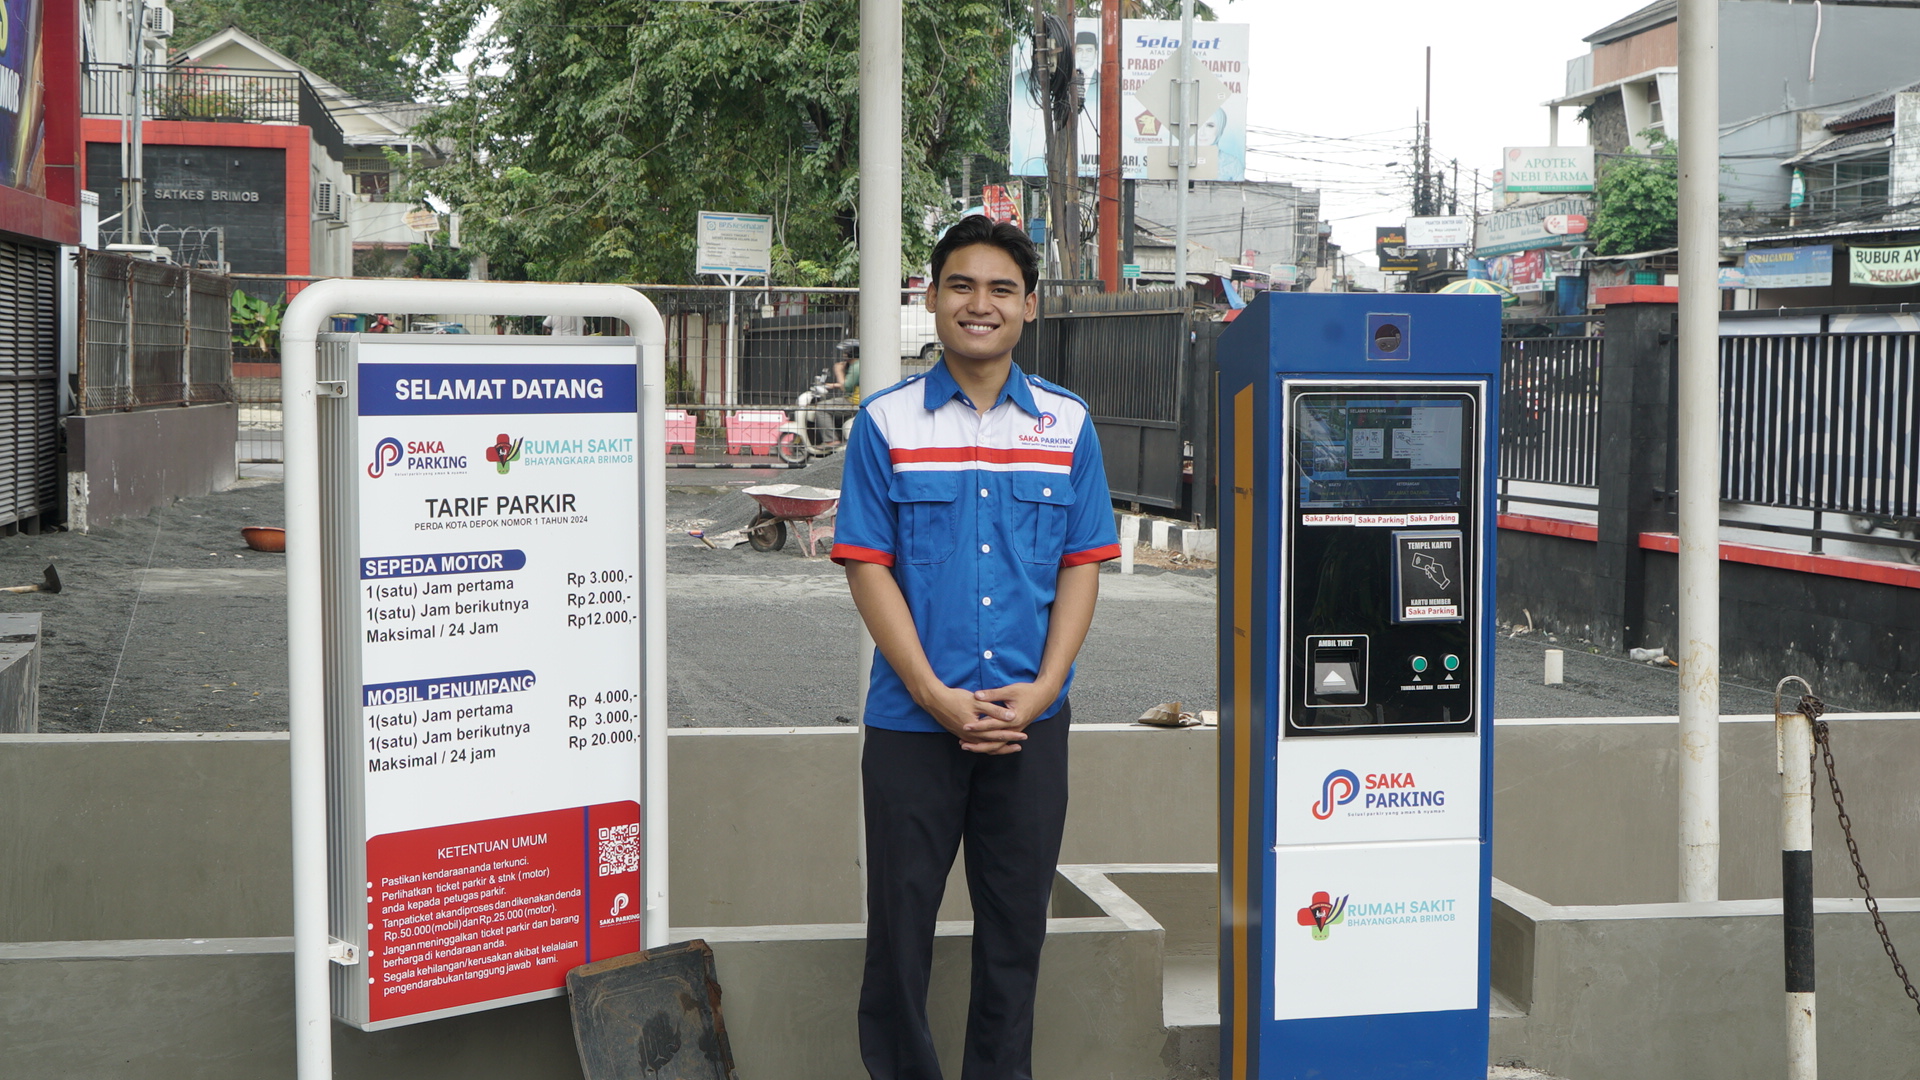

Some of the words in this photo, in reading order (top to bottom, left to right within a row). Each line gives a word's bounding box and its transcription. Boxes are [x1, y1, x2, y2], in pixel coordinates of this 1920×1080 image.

[1128, 58, 1167, 71] PRABO
[1524, 158, 1577, 169] APOTEK
[1510, 171, 1540, 182] NEBI
[1545, 171, 1589, 182] FARMA
[154, 188, 205, 200] SATKES
[211, 190, 260, 202] BRIMOB
[1486, 210, 1522, 233] APOTEK
[1523, 205, 1546, 226] NEBI
[1856, 250, 1900, 264] BUBUR
[395, 378, 506, 400] SELAMAT
[512, 378, 604, 399] DATANG
[407, 441, 445, 454] SAKA
[525, 439, 583, 455] RUMAH
[587, 438, 633, 453] SAKIT
[1018, 435, 1040, 443] SAKA
[1040, 437, 1073, 445] PARKING
[408, 456, 467, 470] PARKING
[525, 455, 596, 467] BHAYANGKARA
[598, 454, 633, 464] BRIMOB
[425, 496, 489, 519] TARIF
[497, 493, 577, 515] PARKIR
[414, 521, 443, 531] PERDA
[446, 519, 468, 529] KOTA
[469, 518, 499, 528] DEPOK
[501, 517, 532, 527] NOMOR
[534, 517, 539, 526] 1
[541, 516, 568, 525] TAHUN
[570, 515, 588, 524] 2024
[1325, 515, 1353, 523] Parking
[1377, 517, 1405, 525] Parking
[1429, 514, 1456, 523] Parking
[1407, 541, 1431, 550] TEMPEL
[1431, 541, 1452, 549] KARTU
[365, 557, 437, 577] SEPEDA
[441, 553, 503, 572] MOTOR
[422, 582, 452, 595] Jam
[457, 578, 514, 597] pertama
[567, 572, 585, 587] Rp
[589, 569, 633, 585] 3.000,-
[420, 603, 450, 618] Jam
[455, 598, 529, 616] berikutnya
[567, 593, 585, 608] Rp
[588, 590, 631, 606] 2.000,-
[1410, 598, 1428, 606] KARTU
[1428, 598, 1451, 606] MEMBER
[1427, 607, 1455, 616] Parking
[367, 625, 436, 643] Maksimal
[440, 624, 445, 638] /
[448, 623, 465, 637] 24
[469, 621, 499, 635] Jam
[1318, 639, 1337, 647] AMBIL
[1337, 639, 1354, 647] TIKET
[367, 687, 423, 706] MOBIL
[428, 675, 535, 700] PENUMPANG
[422, 708, 451, 723] Jam
[456, 704, 513, 723] pertama
[568, 694, 587, 709] Rp
[594, 688, 638, 705] 4.000,-
[422, 731, 451, 745] Jam
[456, 722, 530, 742] berikutnya
[568, 714, 587, 729] Rp
[594, 709, 638, 726] 3.000,-
[368, 753, 437, 773] Maksimal
[441, 751, 446, 766] /
[450, 749, 467, 764] 24
[470, 747, 496, 764] jam
[568, 735, 587, 751] Rp
[591, 729, 641, 747] 20.000,-
[1365, 772, 1415, 790] SAKA
[1366, 790, 1445, 809] PARKING
[437, 838, 509, 860] KETENTUAN
[511, 833, 548, 848] UMUM
[381, 874, 421, 887] Pastikan
[493, 856, 529, 870] terkunci.
[381, 886, 433, 901] Perlihatkan
[436, 881, 460, 893] ticket
[462, 876, 487, 890] parkir
[488, 874, 496, 885] &
[498, 872, 516, 883] stnk
[381, 902, 405, 915] anda
[407, 897, 441, 910] kepada
[443, 892, 479, 906] petugas
[480, 886, 507, 900] parkir.
[1347, 902, 1405, 917] RUMAH
[1409, 899, 1456, 914] SAKIT
[480, 926, 504, 939] ticket
[506, 922, 530, 936] parkir
[532, 919, 548, 930] dan
[550, 914, 580, 926] barang
[599, 918, 615, 926] SAKA
[615, 913, 640, 923] PARKING
[1347, 916, 1418, 927] BHAYANGKARA
[1420, 914, 1455, 924] BRIMOB
[435, 943, 482, 959] kendaraan
[482, 939, 507, 950] anda.
[383, 969, 415, 983] Segala
[416, 951, 513, 976] kehilangan/kerusakan
[513, 946, 540, 959] akibat
[541, 940, 578, 954] kelalaian
